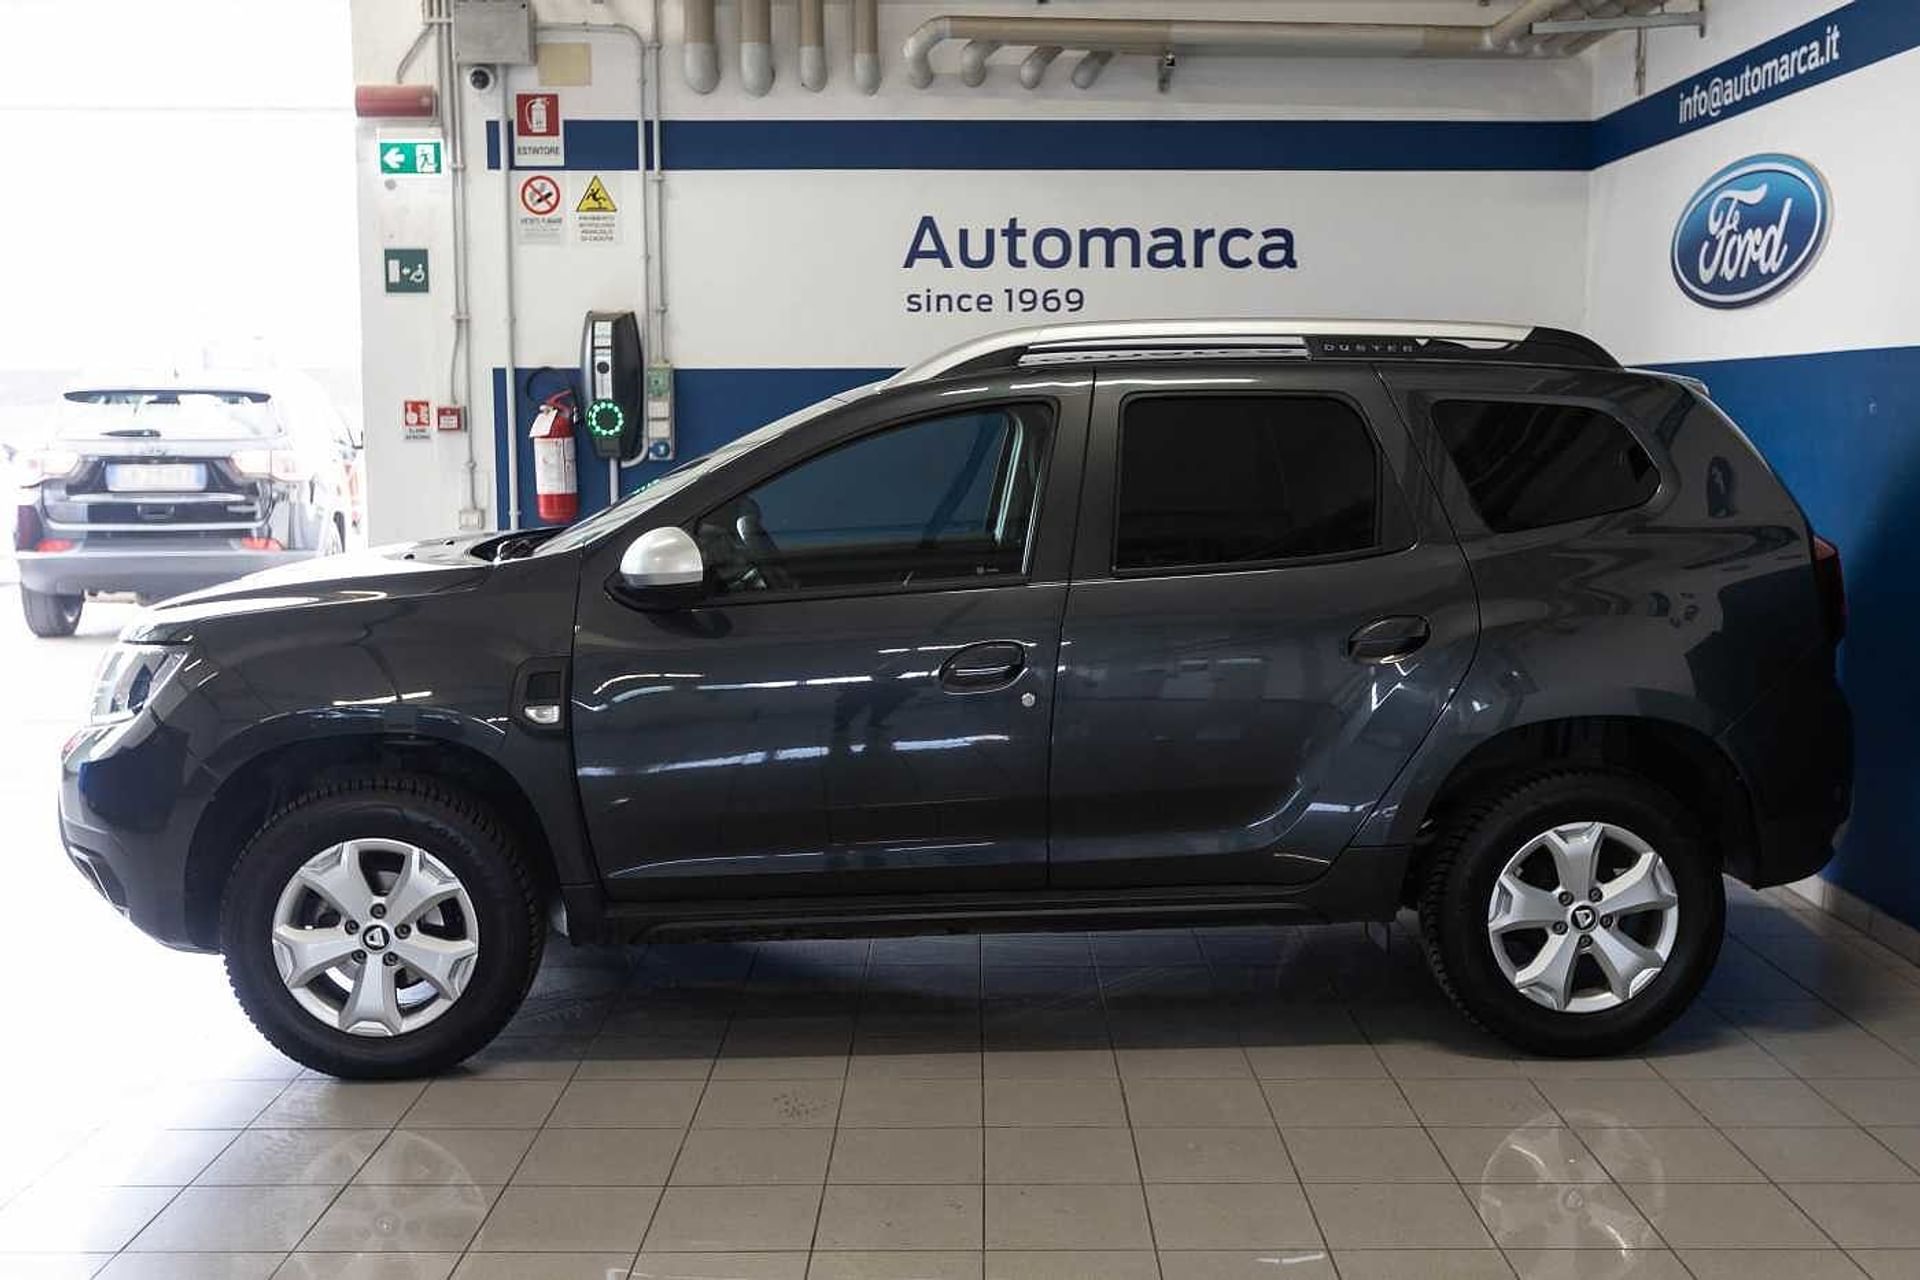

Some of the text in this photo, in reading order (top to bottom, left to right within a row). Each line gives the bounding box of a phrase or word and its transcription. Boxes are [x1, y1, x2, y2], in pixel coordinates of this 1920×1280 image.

[1678, 25, 1841, 124] info@automarca.it
[902, 215, 1297, 269] Automarca
[1699, 183, 1792, 285] Ford
[906, 288, 1085, 313] since 1969
[1323, 343, 1413, 353] DUSTER
